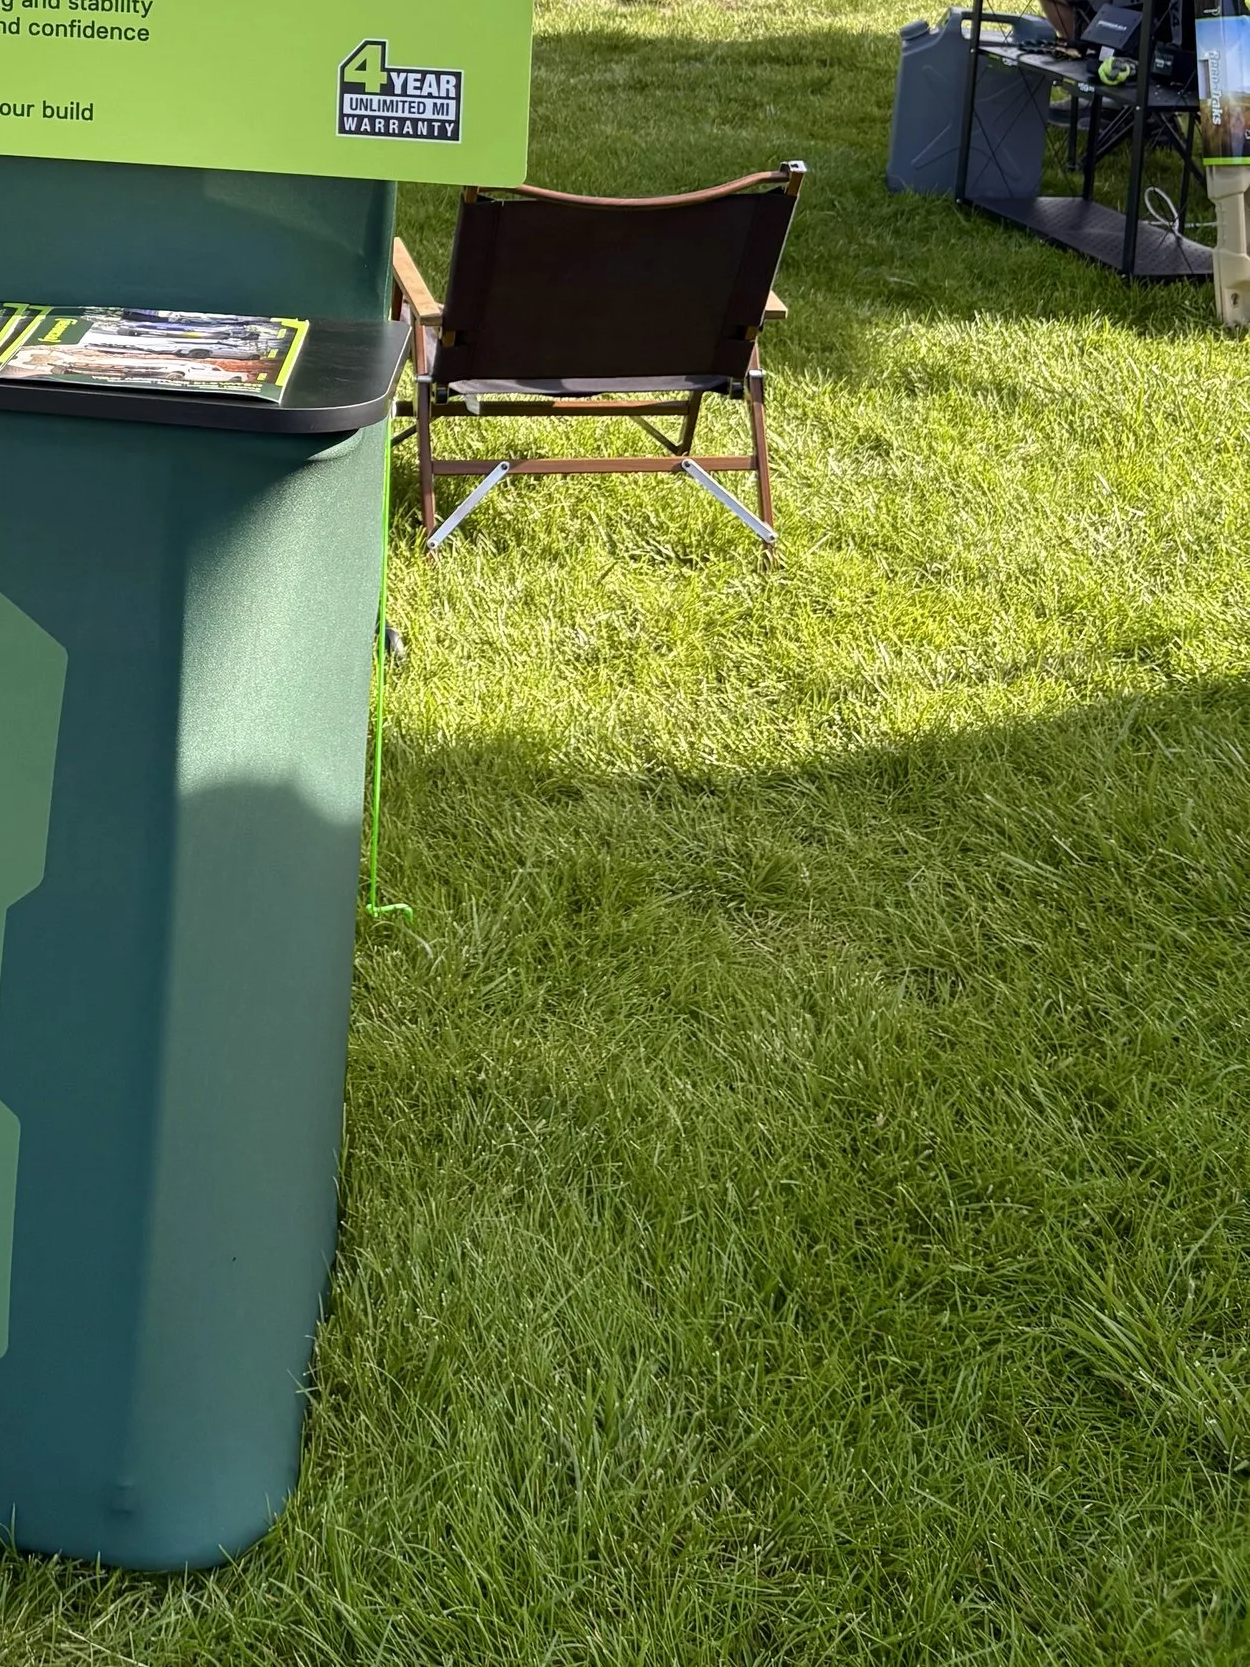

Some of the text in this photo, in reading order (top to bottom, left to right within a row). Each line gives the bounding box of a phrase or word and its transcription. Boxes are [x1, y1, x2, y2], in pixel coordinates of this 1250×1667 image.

[28, 19, 150, 42] confidence
[343, 44, 456, 97] 4 YEAR
[42, 100, 94, 121] build
[349, 97, 450, 117] UNLIMITED MI
[343, 117, 455, 137] WARRANTY
